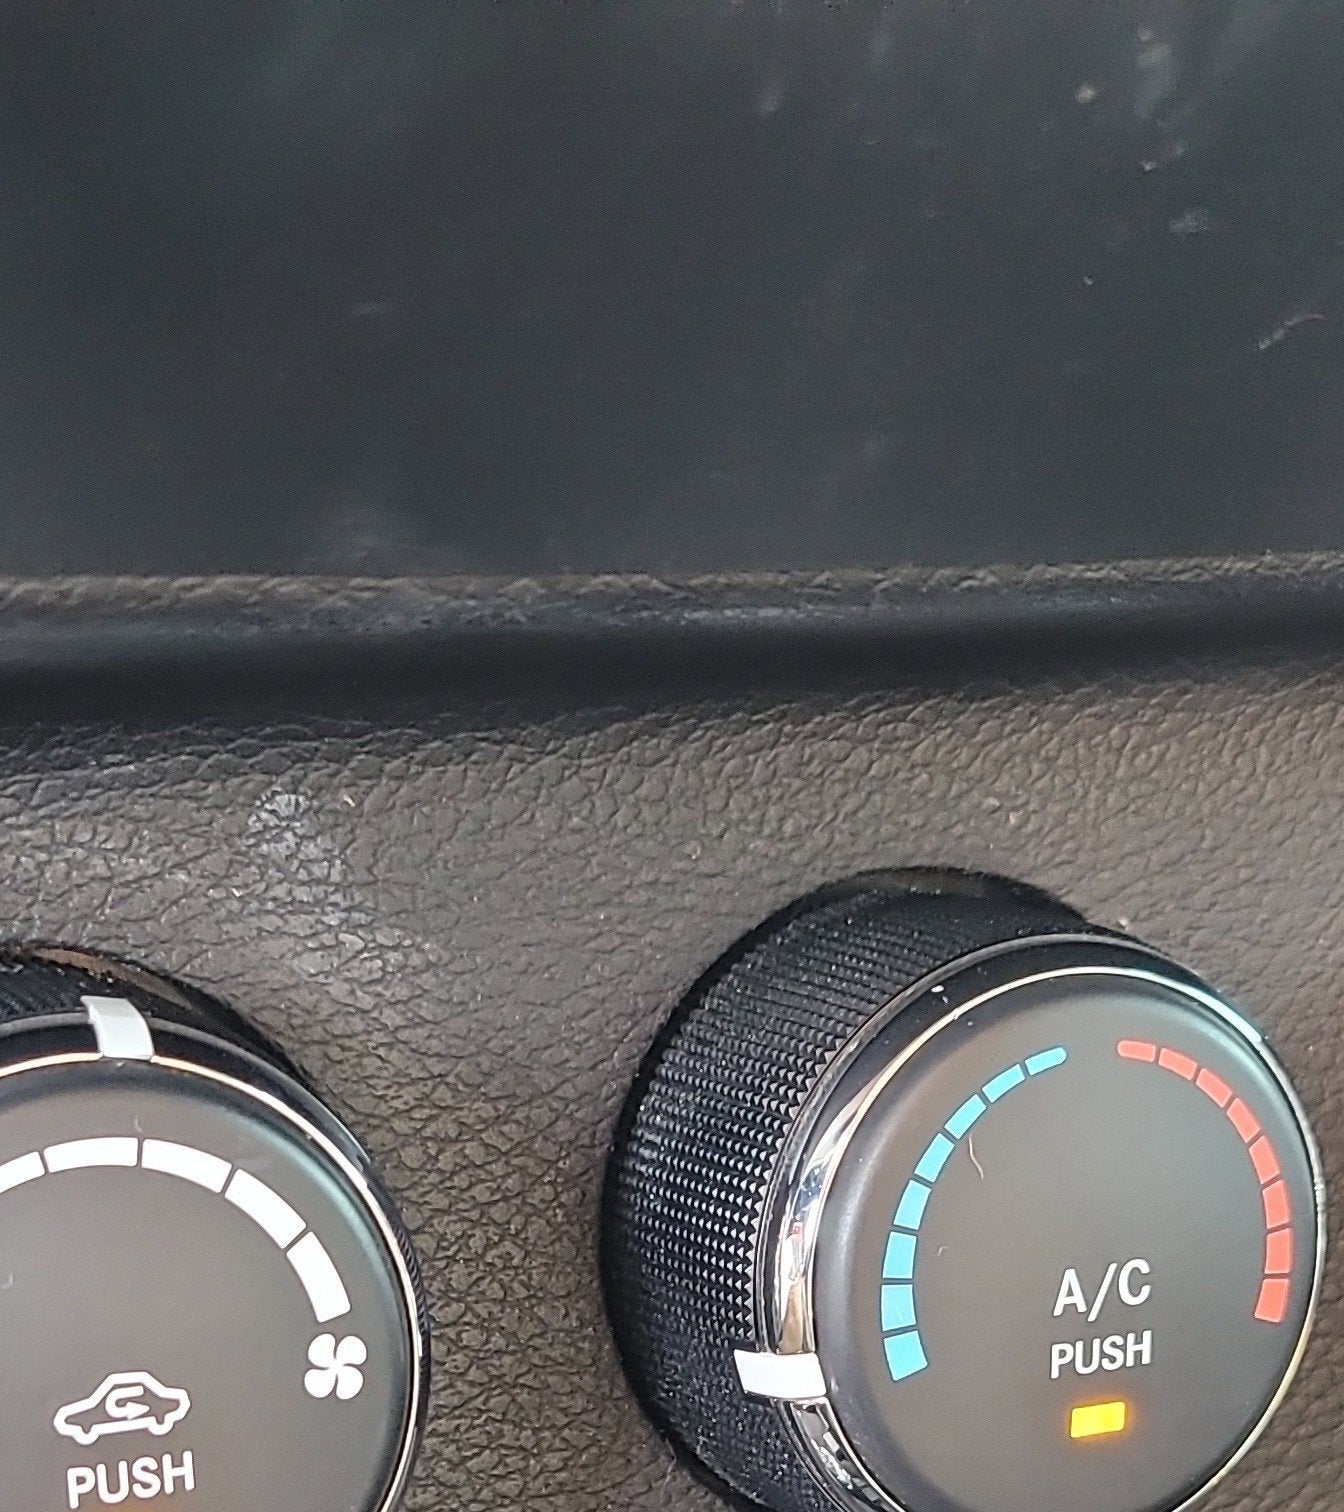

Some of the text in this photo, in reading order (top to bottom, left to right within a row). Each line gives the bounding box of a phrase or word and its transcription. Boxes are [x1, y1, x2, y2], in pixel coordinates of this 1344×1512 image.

[1052, 1258, 1151, 1322] A/C
[1050, 1330, 1153, 1379] PUSH
[66, 1450, 196, 1509] PUSH
